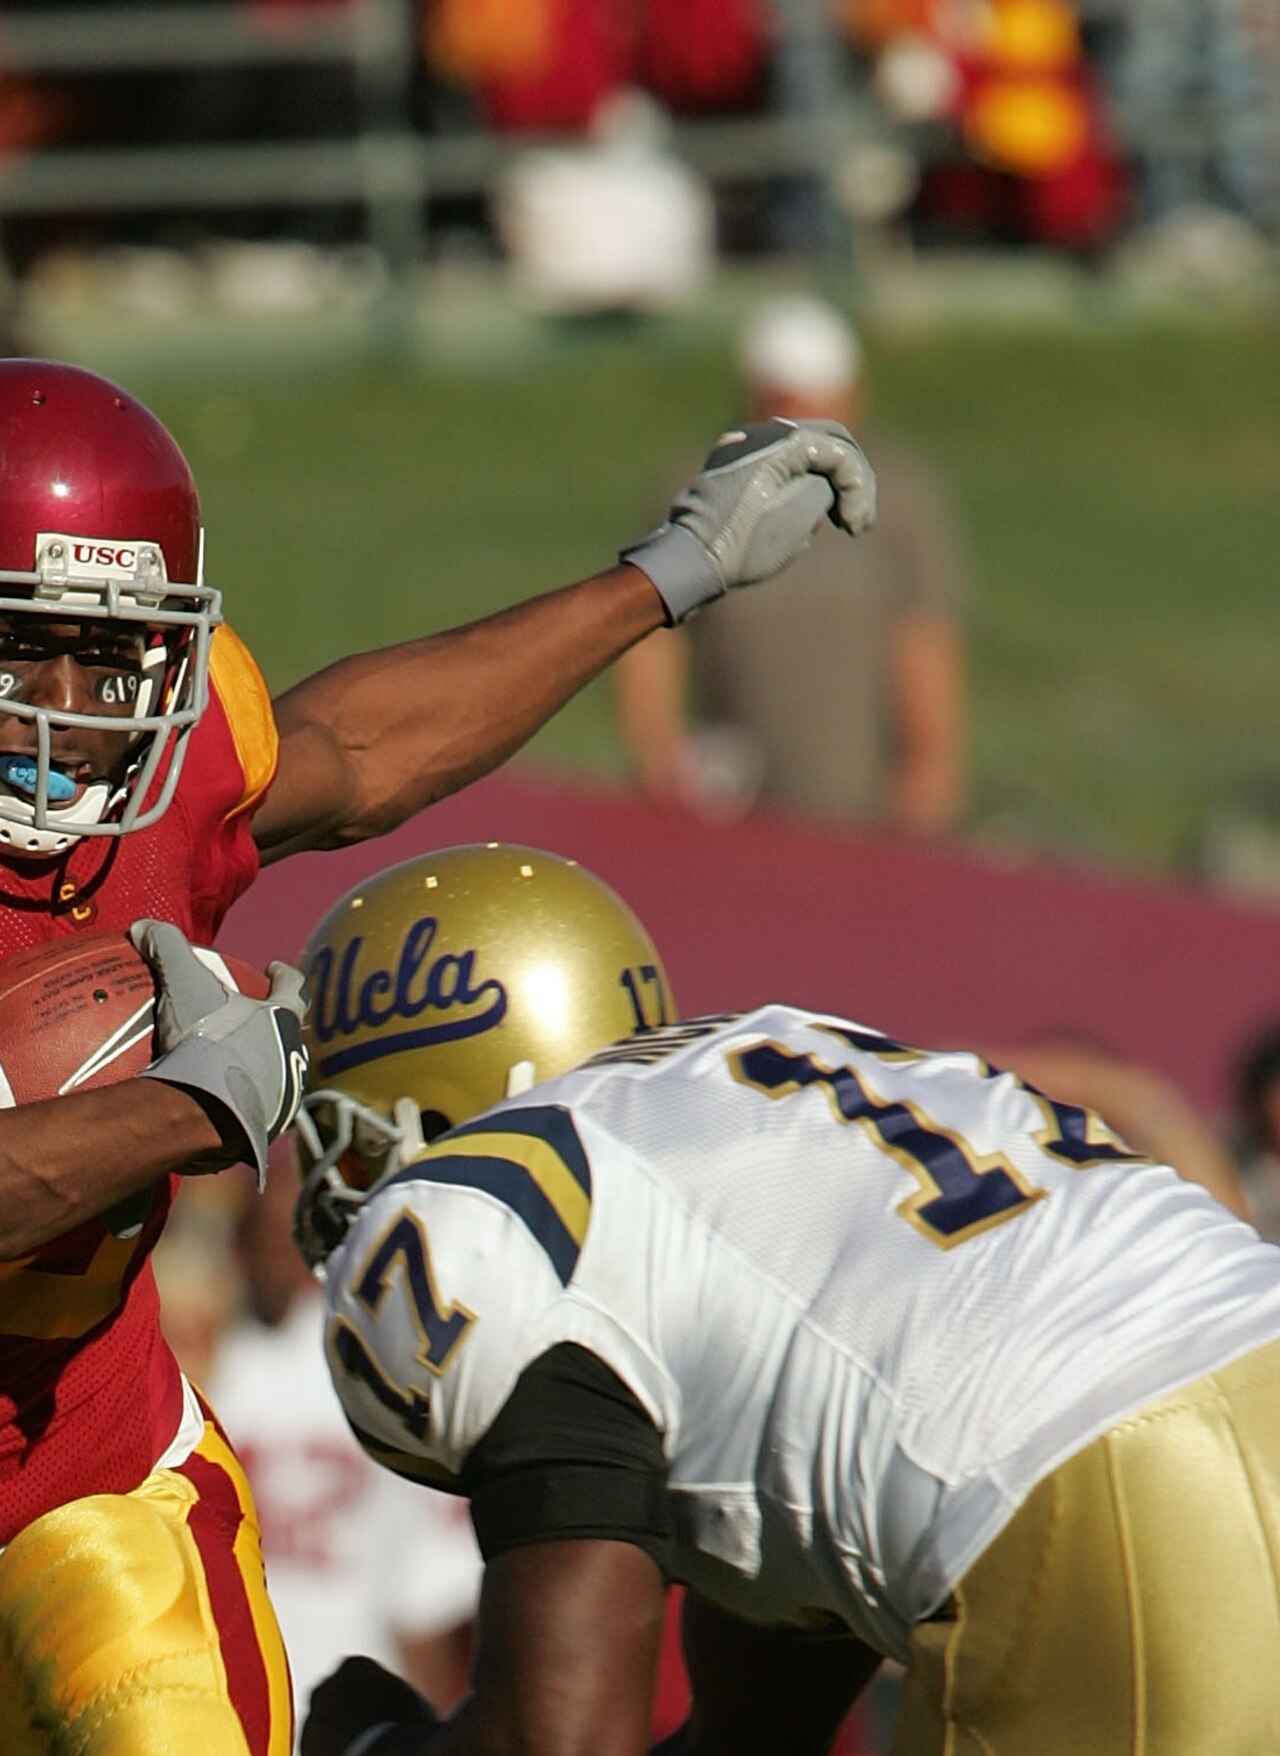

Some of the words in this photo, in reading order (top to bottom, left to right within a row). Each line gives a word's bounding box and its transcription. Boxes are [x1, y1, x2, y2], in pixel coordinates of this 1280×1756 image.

[72, 544, 136, 568] USC
[102, 675, 137, 703] 619
[311, 917, 495, 1050] Ucla
[620, 964, 668, 1035] 17
[329, 1206, 480, 1440] 17
